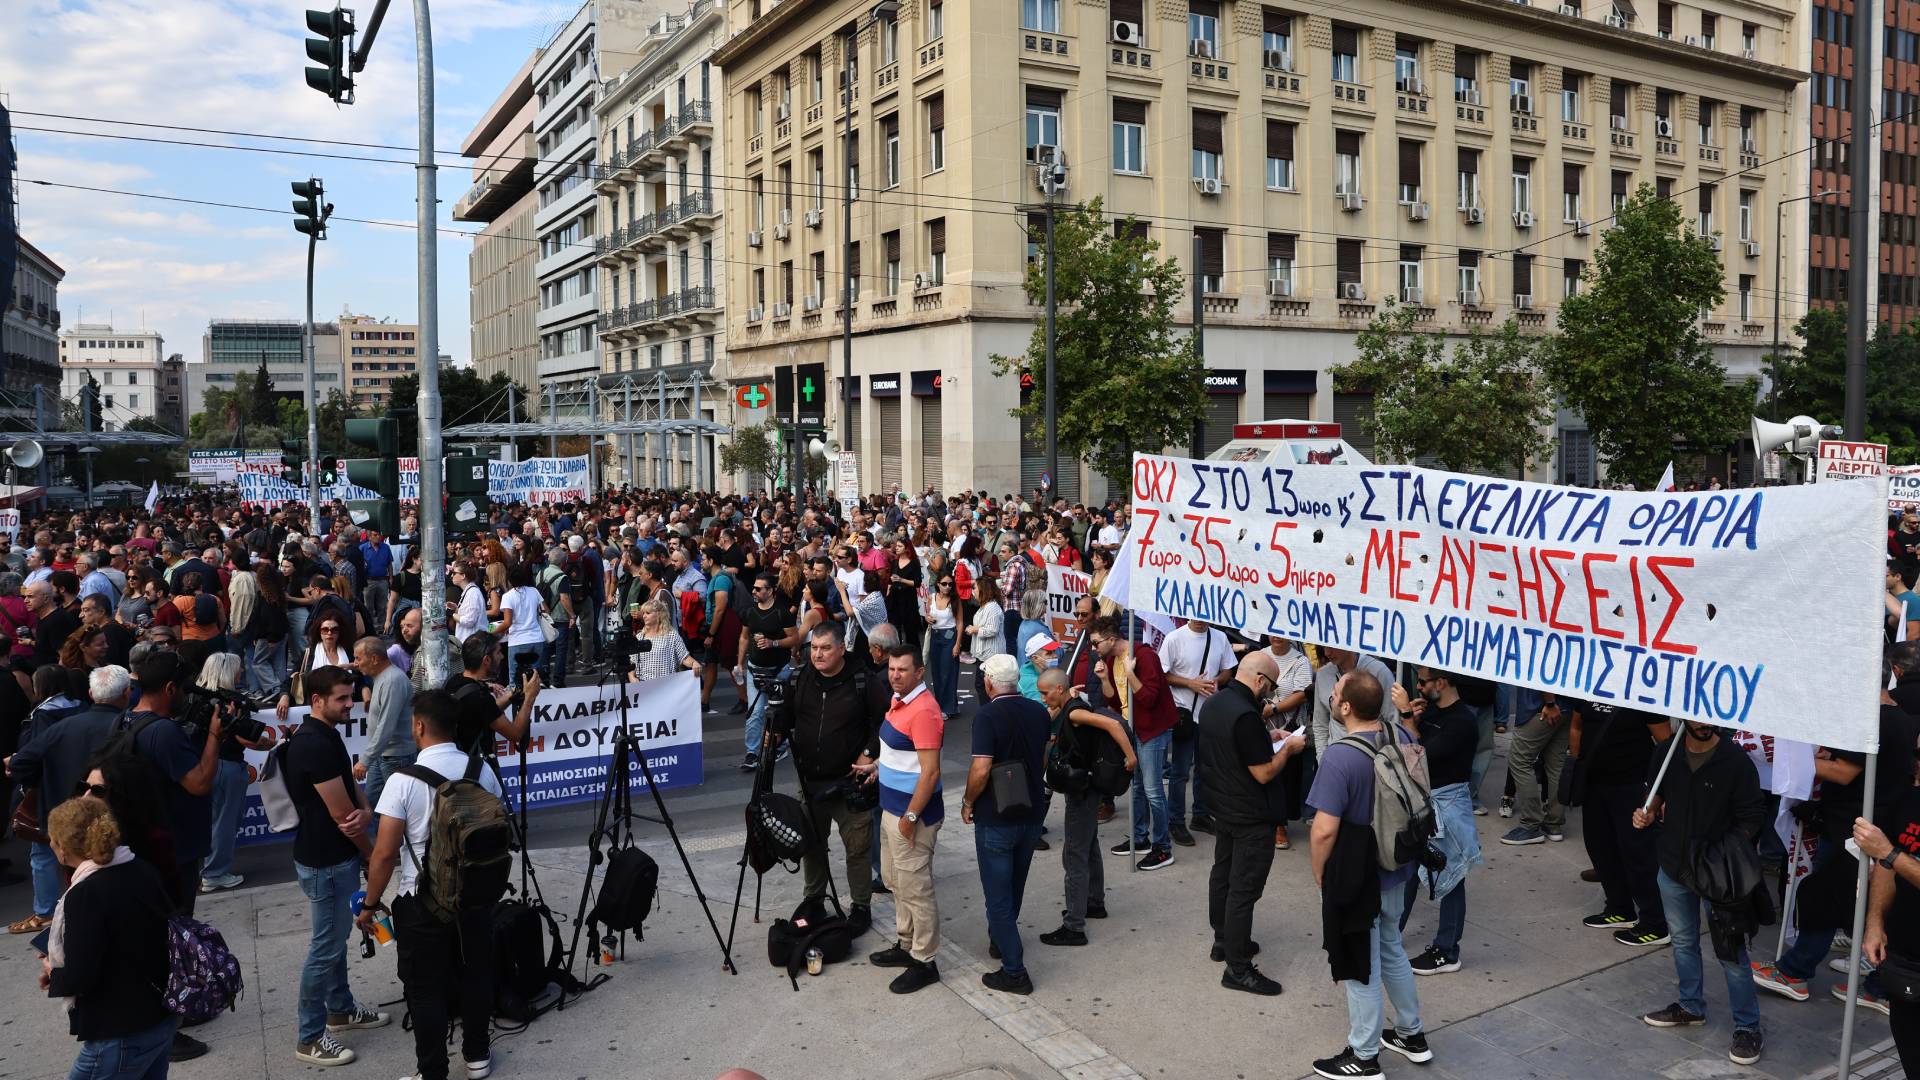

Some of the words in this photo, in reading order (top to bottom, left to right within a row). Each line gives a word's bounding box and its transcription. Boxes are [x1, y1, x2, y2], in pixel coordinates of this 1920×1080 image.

[873, 380, 898, 390] EUROBANK
[1823, 444, 1884, 463] ΠΑΜΕ
[1827, 461, 1881, 476] ΑΠΕΡΓΙΑ
[1133, 457, 1177, 504] ΟΧΙ
[1187, 462, 1251, 512] ΣΤΟ
[1617, 491, 1764, 551] ΩΡΑΡΙΑ
[1359, 527, 1421, 603] ΜΕ
[1428, 534, 1699, 656] ΑΥΞΗΣΕΙΣ
[1155, 576, 1248, 630] ΚΛΑΔΙΚΟ
[1266, 592, 1407, 656] ΣΩΜΑΤΕΙΟ
[1420, 613, 1766, 724] ΧΡΗΜΑΤΟΠΙΣΤΩΤΙΚΟΥ
[531, 693, 640, 725] ΚΛΑΒΙΑ!
[532, 766, 608, 785] ΔΗΜΟΣΙΩΝ
